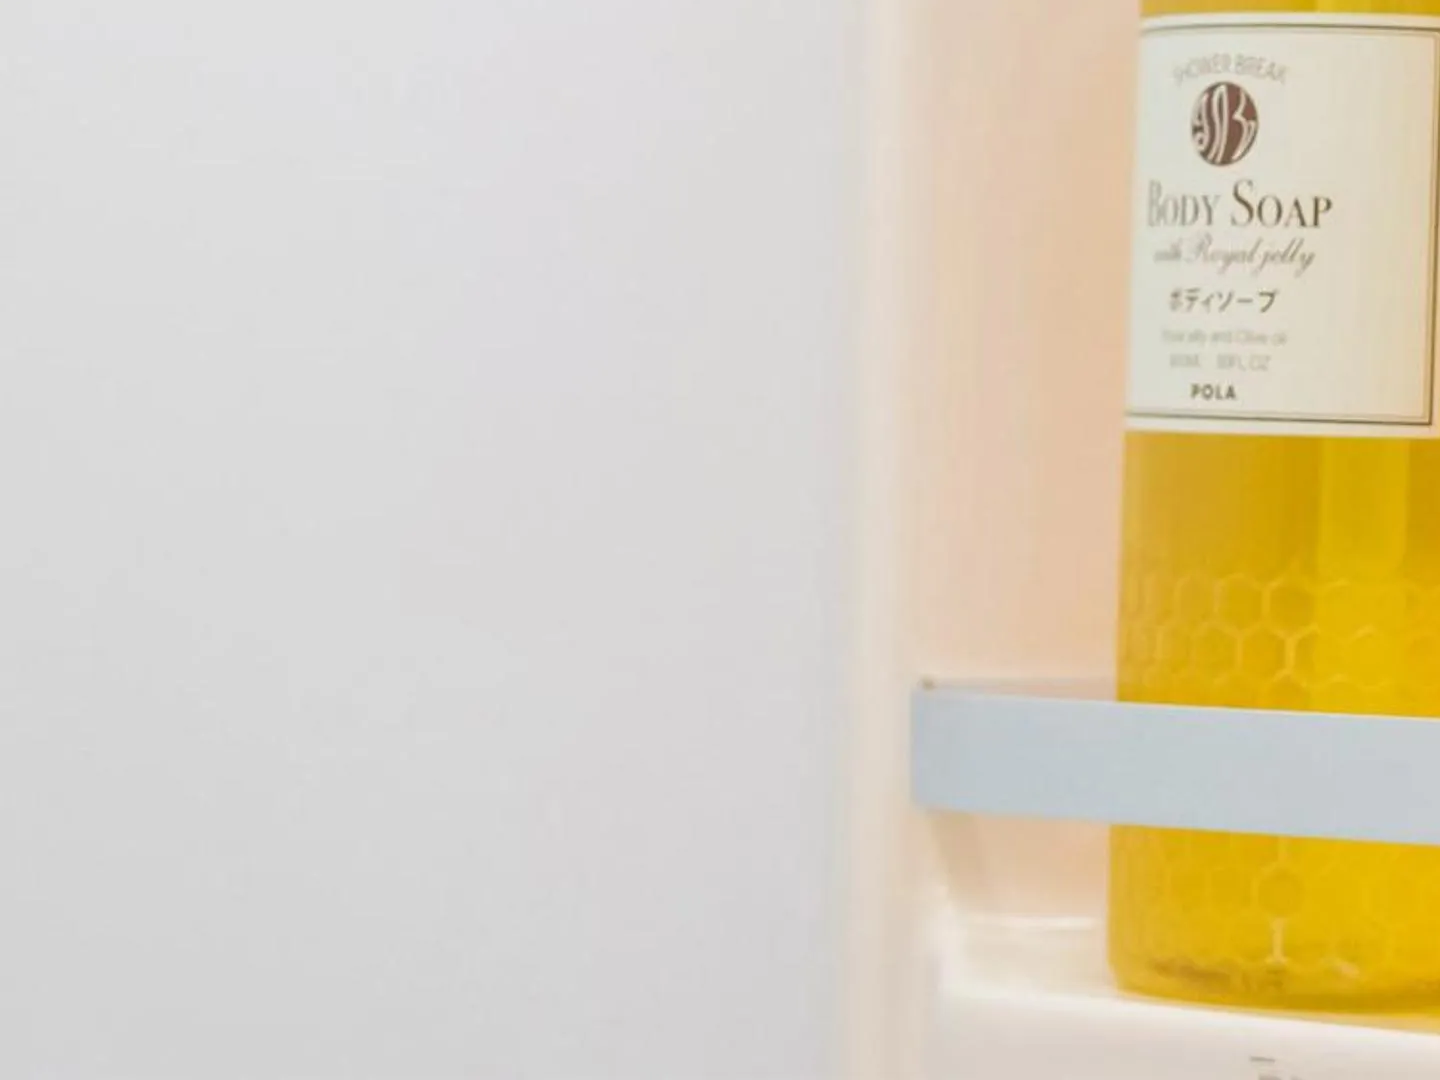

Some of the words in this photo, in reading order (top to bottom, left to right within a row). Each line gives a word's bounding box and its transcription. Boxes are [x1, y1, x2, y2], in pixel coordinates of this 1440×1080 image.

[1184, 232, 1263, 275] Royal
[1250, 236, 1315, 278] jelly
[1190, 383, 1237, 401] POLA
